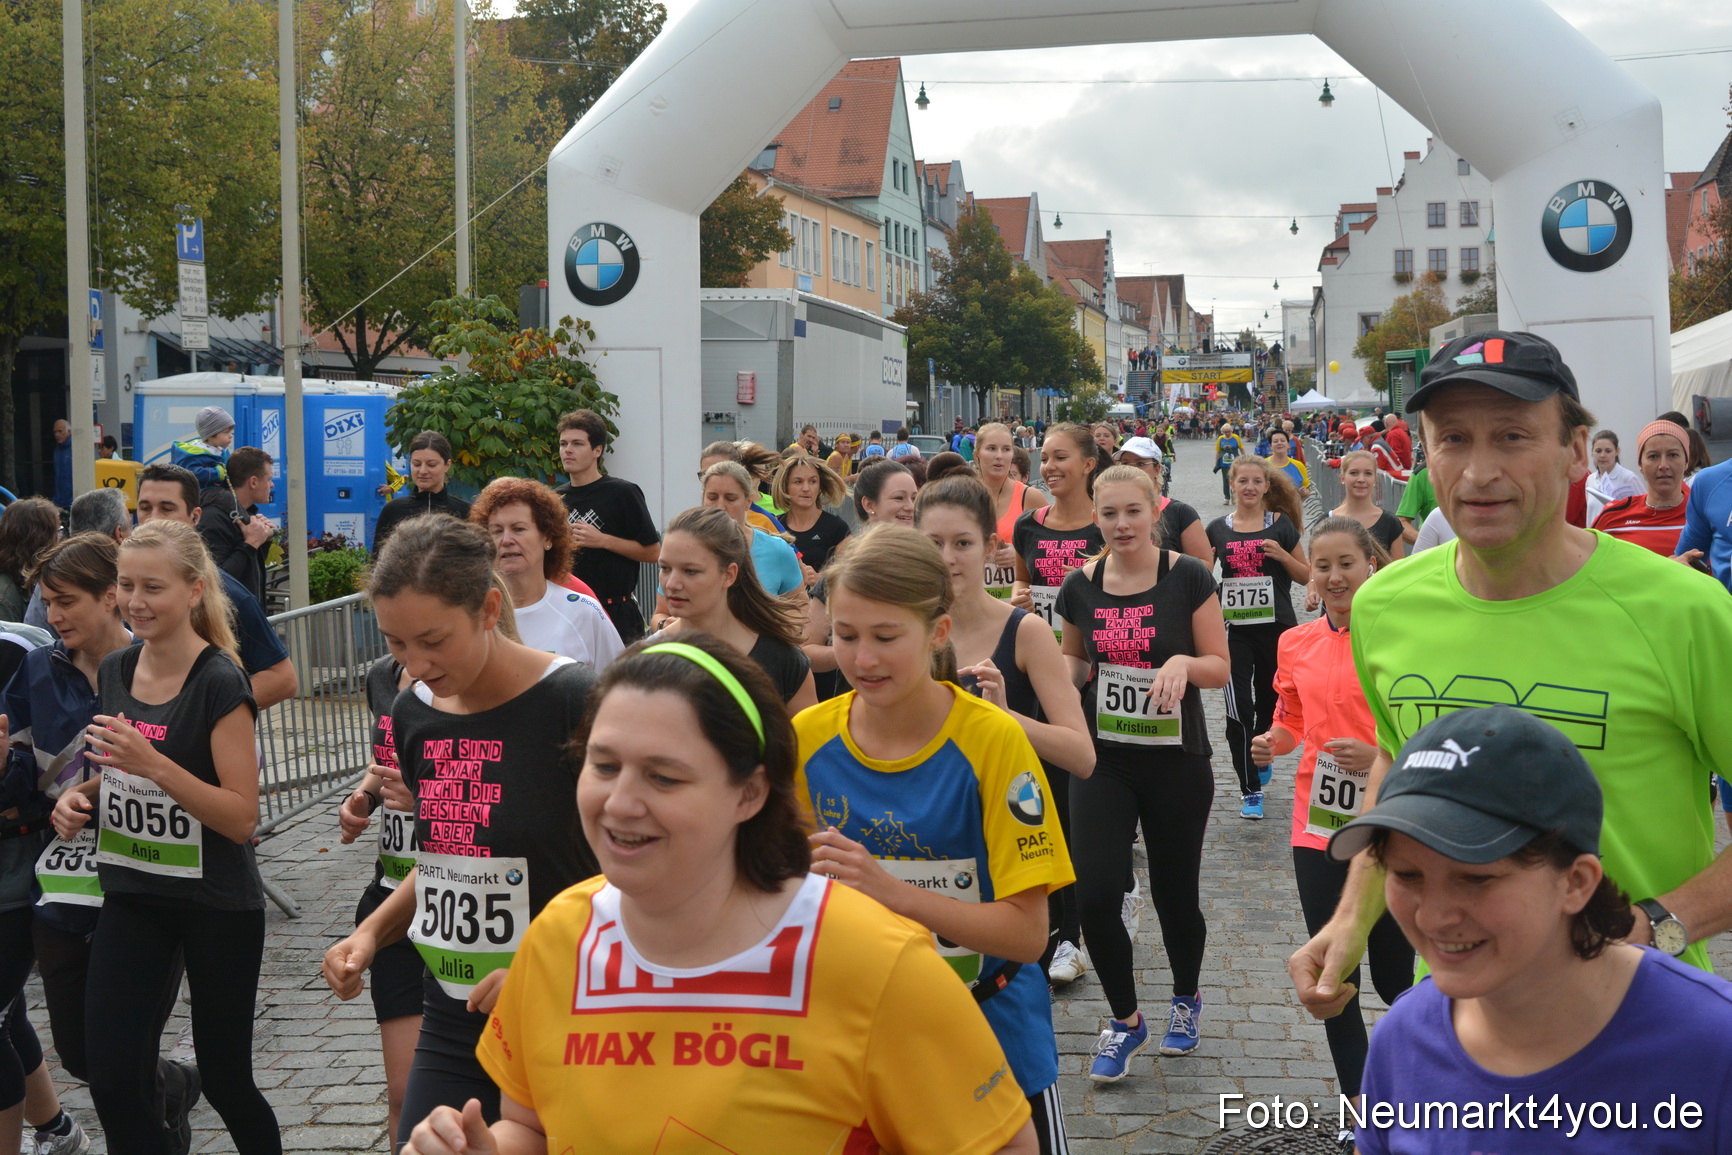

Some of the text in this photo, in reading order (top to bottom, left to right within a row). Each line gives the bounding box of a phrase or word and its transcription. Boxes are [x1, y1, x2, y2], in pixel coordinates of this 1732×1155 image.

[1548, 182, 1626, 215] BMW
[569, 224, 634, 252] BMW
[124, 373, 132, 392] 3
[1191, 372, 1222, 380] START
[1038, 540, 1087, 549] WIR SIND
[1046, 549, 1075, 557] ZWAR
[1035, 558, 1064, 568] NICHT
[1227, 588, 1269, 607] 5175
[1095, 605, 1153, 618] WIR SIND
[1232, 611, 1263, 620] Angelina
[1107, 617, 1141, 629] ZWAR
[1093, 627, 1155, 640] NICHT DIE
[1108, 651, 1140, 662] ABER
[1100, 669, 1124, 681] PARTL
[1116, 719, 1158, 735] Kristina
[424, 740, 501, 760] WIR SIND
[436, 761, 481, 779] ZWAR
[1402, 750, 1459, 771] PUMA
[103, 773, 127, 792] PARTL
[419, 781, 500, 802] NICHT DIE
[827, 798, 836, 807] 15
[108, 792, 190, 839] 5056
[431, 823, 474, 843] ABER
[132, 843, 160, 862] Anja
[418, 864, 499, 885] PARTL Neumarkt
[421, 886, 514, 945] 5035
[439, 956, 475, 979] Julia
[563, 1023, 804, 1071] MAX BÖGL
